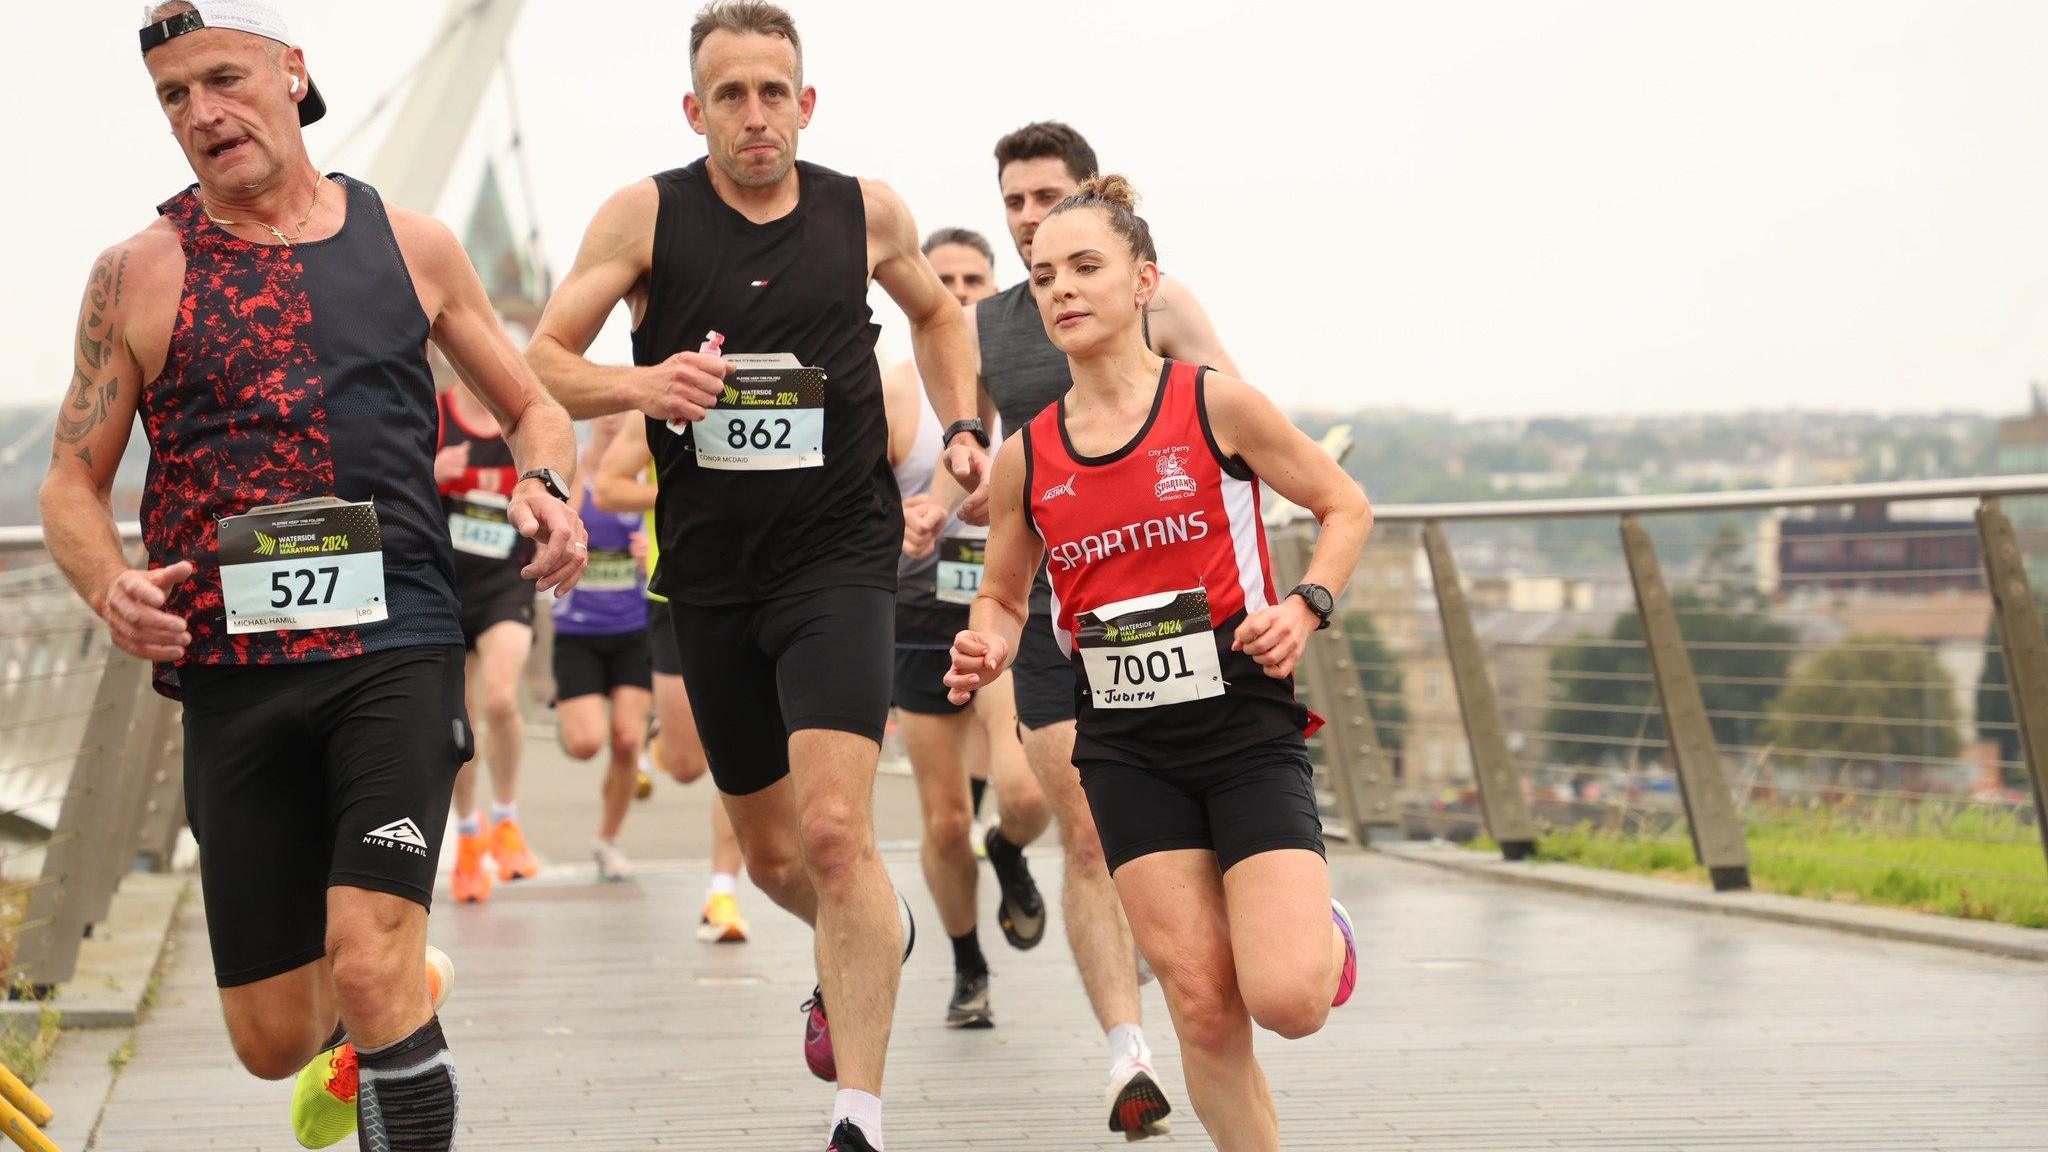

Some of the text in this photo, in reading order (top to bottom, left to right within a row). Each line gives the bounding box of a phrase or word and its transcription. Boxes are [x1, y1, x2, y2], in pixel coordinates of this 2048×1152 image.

[776, 392, 798, 405] 2024
[727, 418, 791, 449] 862
[1148, 445, 1190, 457] City of Derry
[700, 454, 721, 462] CONOR
[1155, 478, 1196, 497] SPARTANS
[1160, 494, 1183, 502] Athletics
[278, 534, 316, 542] WATERSIDE
[321, 534, 349, 552] 2024
[1051, 510, 1208, 571] SPARTANS
[279, 541, 297, 549] HALF
[280, 545, 320, 555] MARATHON
[270, 566, 339, 609] 527
[358, 608, 372, 616] LRG
[233, 615, 298, 627] MICHAEL HAMILL
[1119, 621, 1152, 632] WATERSIDE
[1157, 619, 1182, 636] 2024
[1121, 631, 1157, 642] MARATHON
[1106, 646, 1195, 685] 7001
[1104, 689, 1155, 704] JUDITH
[362, 836, 427, 857] NIKE TRAIL
